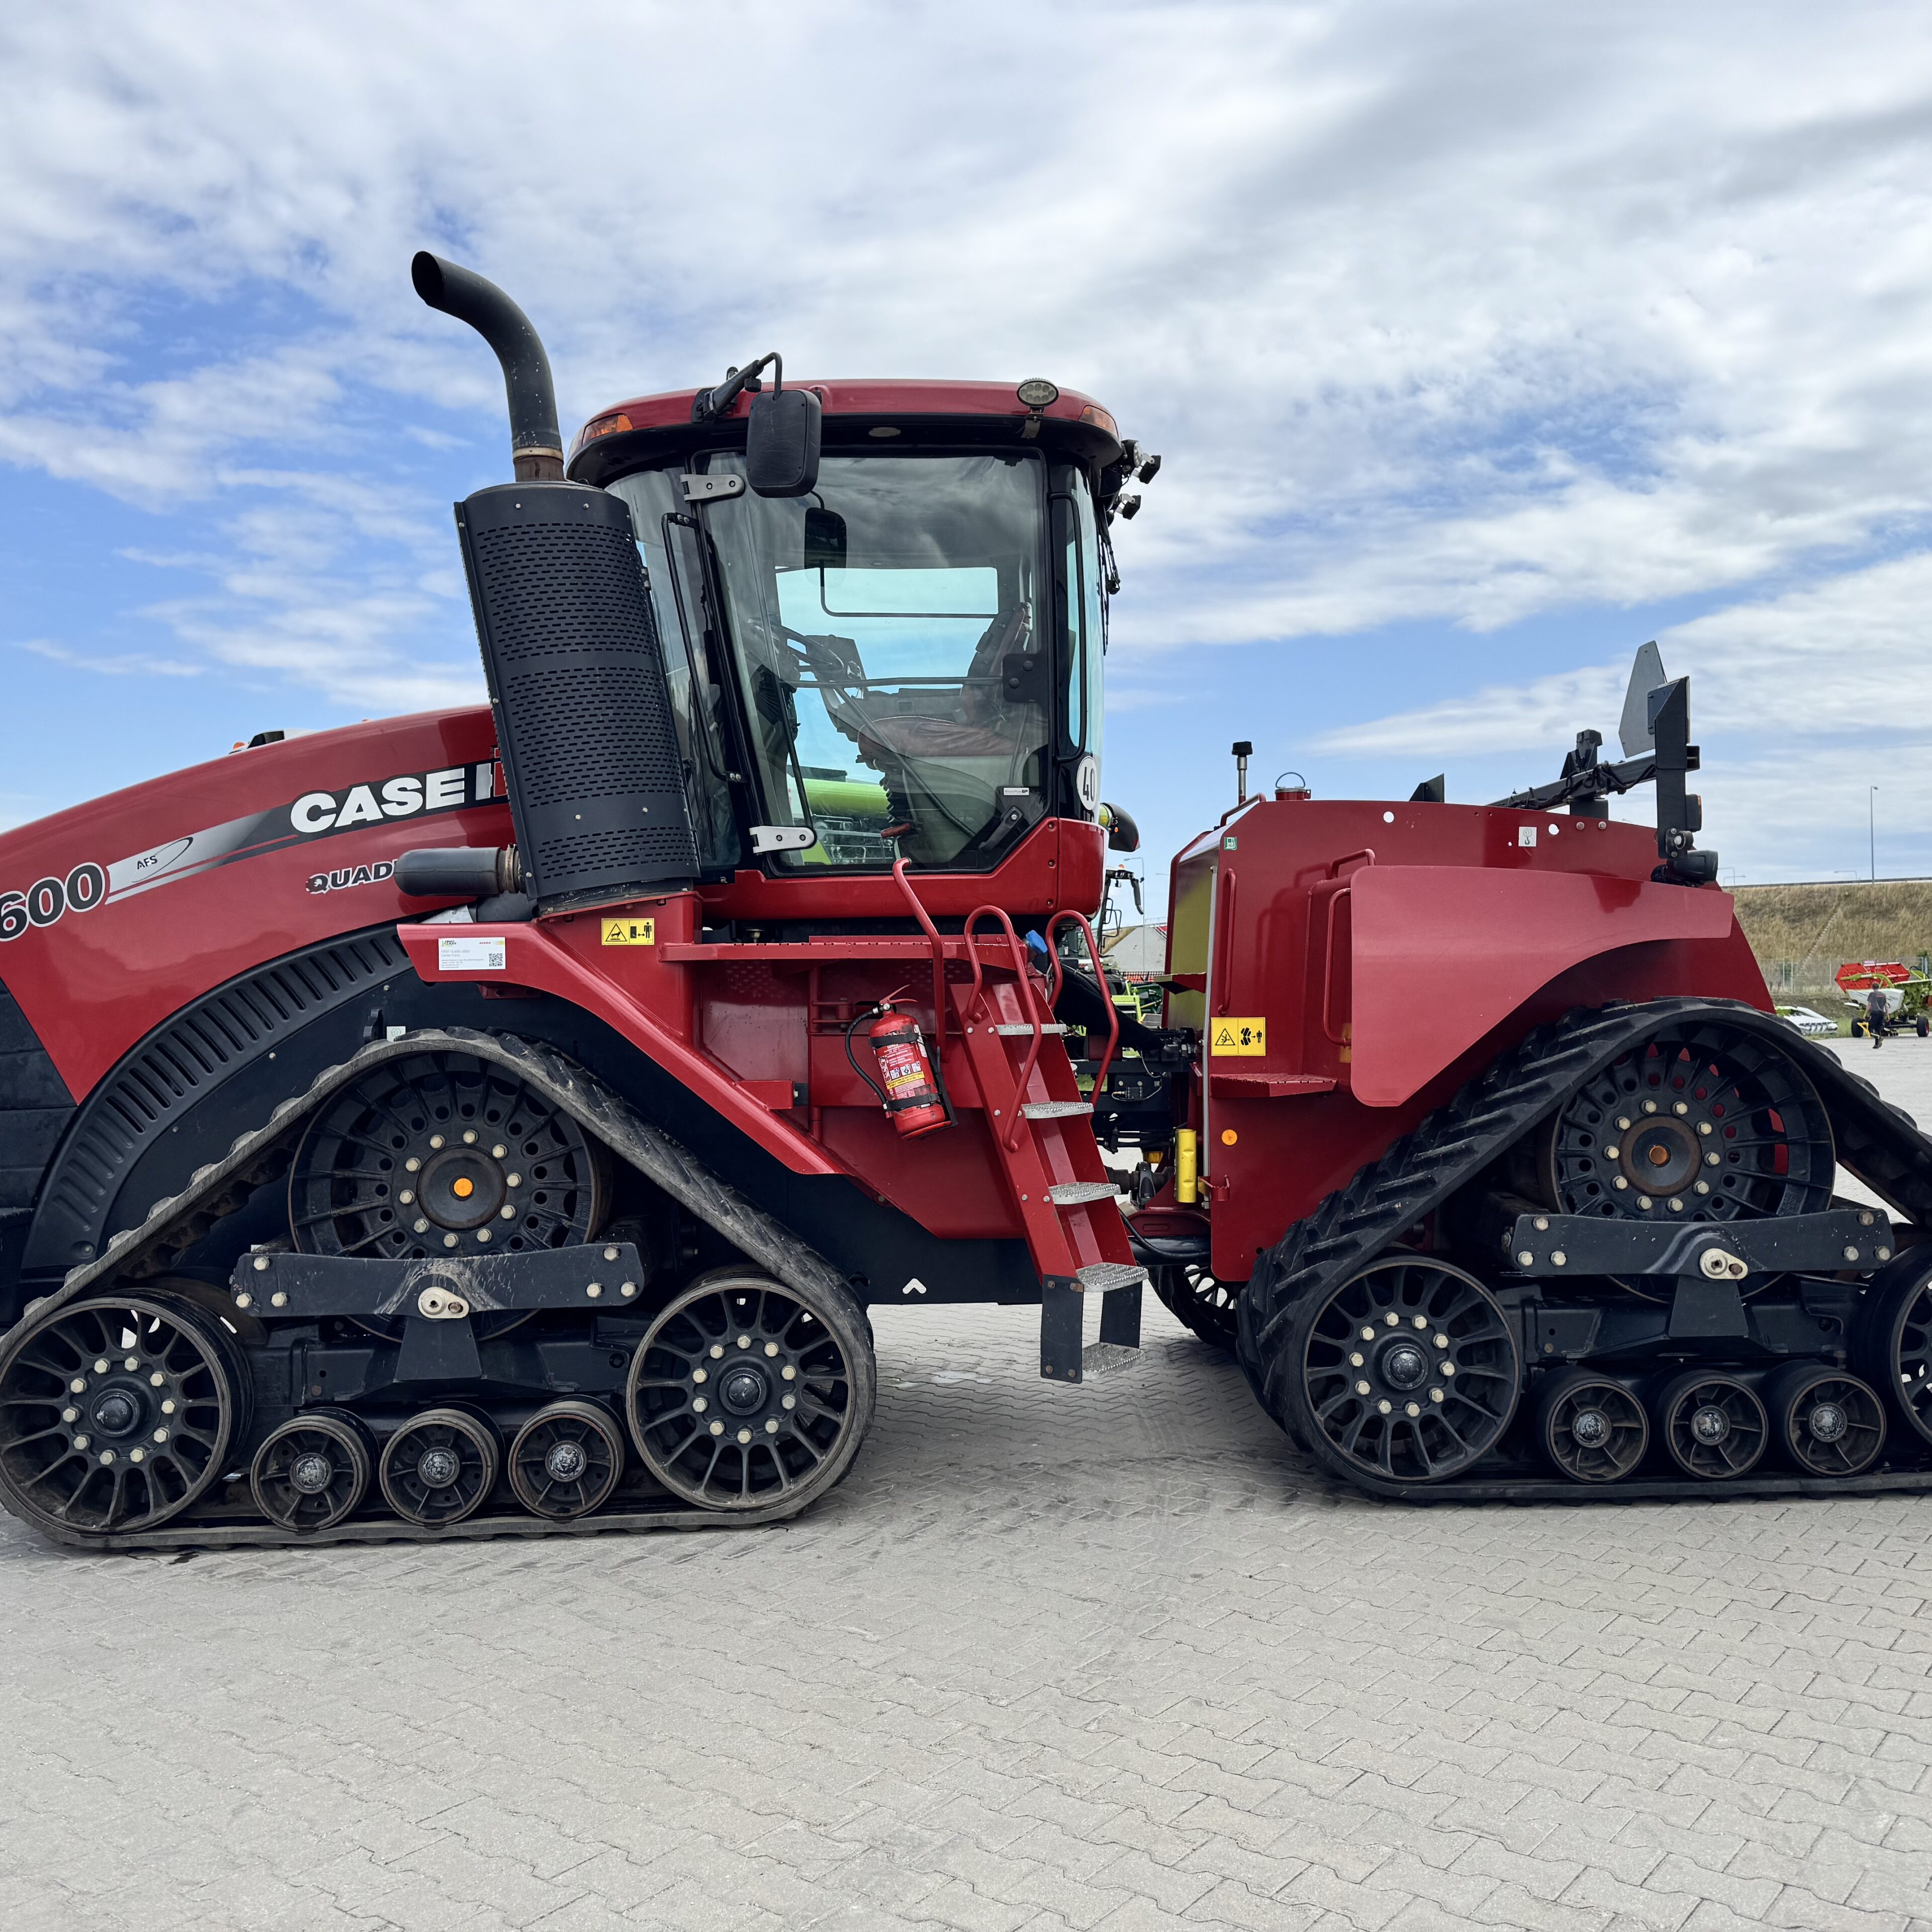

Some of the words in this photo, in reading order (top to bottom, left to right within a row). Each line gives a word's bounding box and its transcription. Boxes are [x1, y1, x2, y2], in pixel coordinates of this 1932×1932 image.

[290, 767, 465, 833] CASE
[1083, 766, 1095, 802] 40
[137, 855, 158, 870] AFS
[305, 858, 398, 894] QUAD
[0, 862, 106, 942] 600
